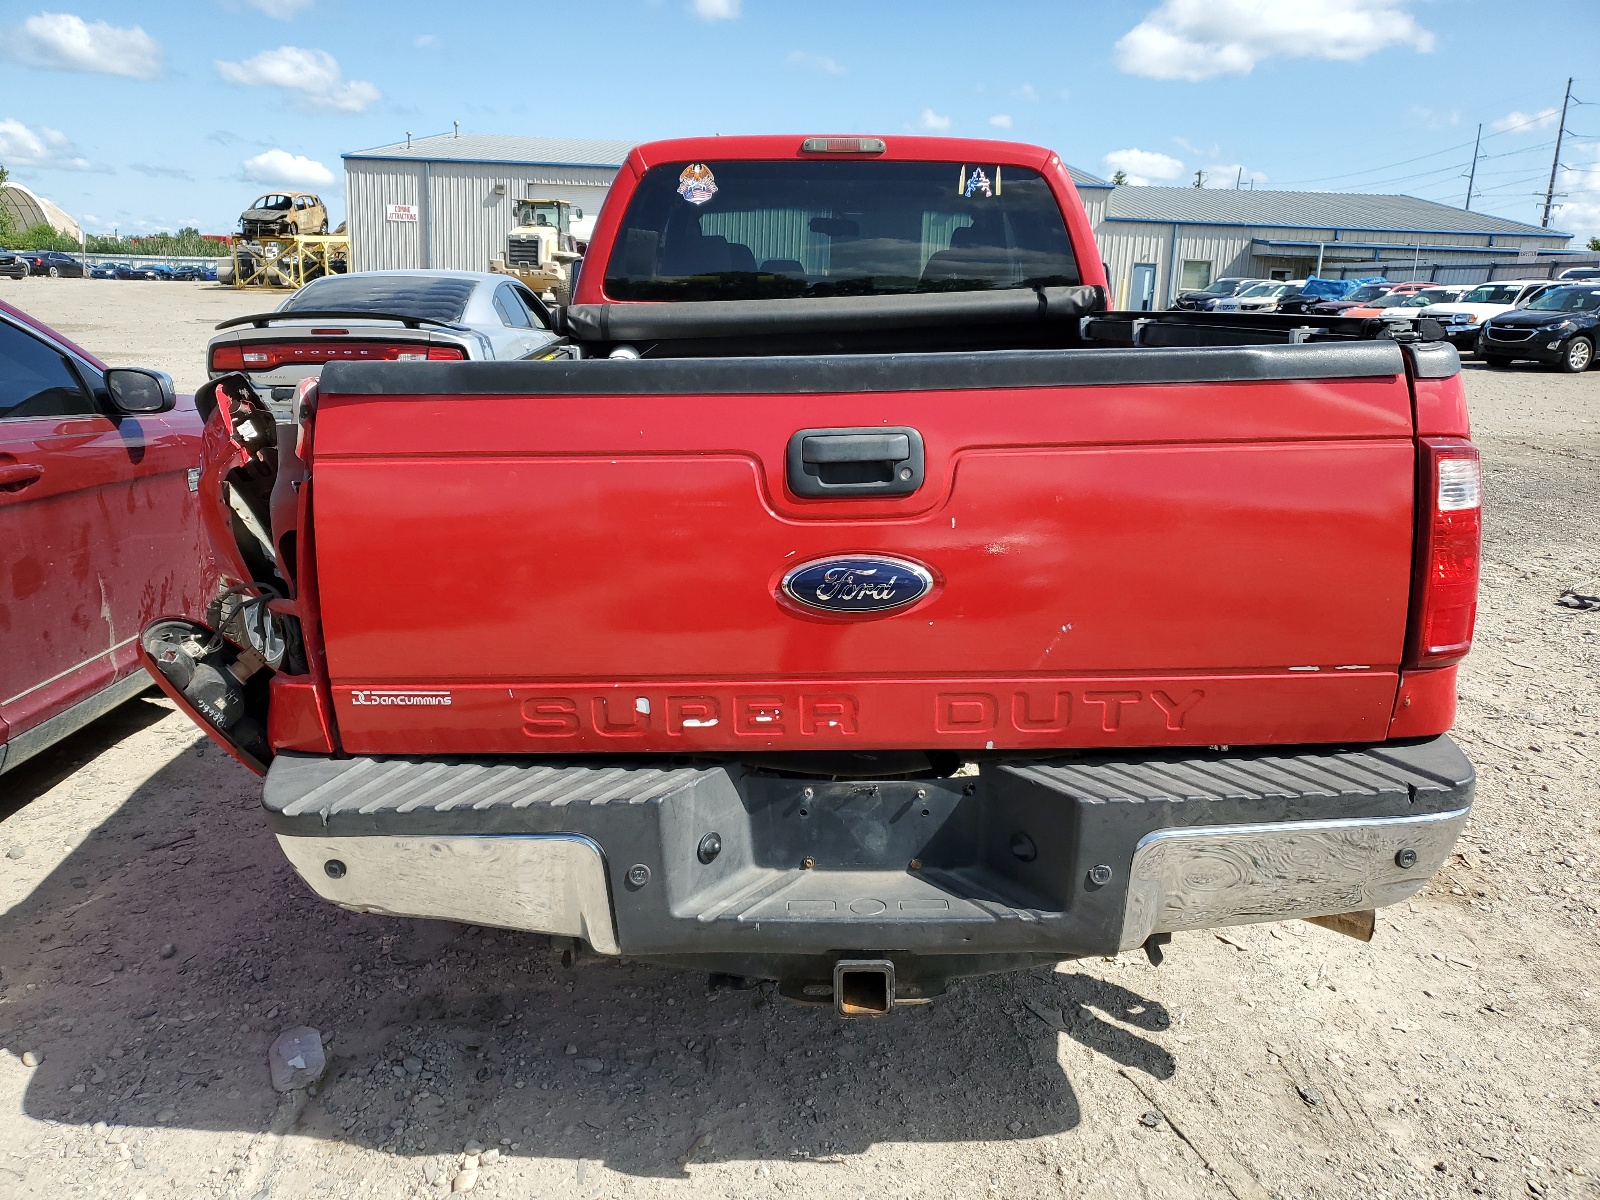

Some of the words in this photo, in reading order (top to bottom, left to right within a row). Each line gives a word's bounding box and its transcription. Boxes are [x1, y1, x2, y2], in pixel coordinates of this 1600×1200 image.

[388, 213, 417, 221] ATTRACTIONS
[816, 567, 898, 601] Ford
[520, 695, 859, 738] SUPER
[935, 689, 1206, 734] DUTY
